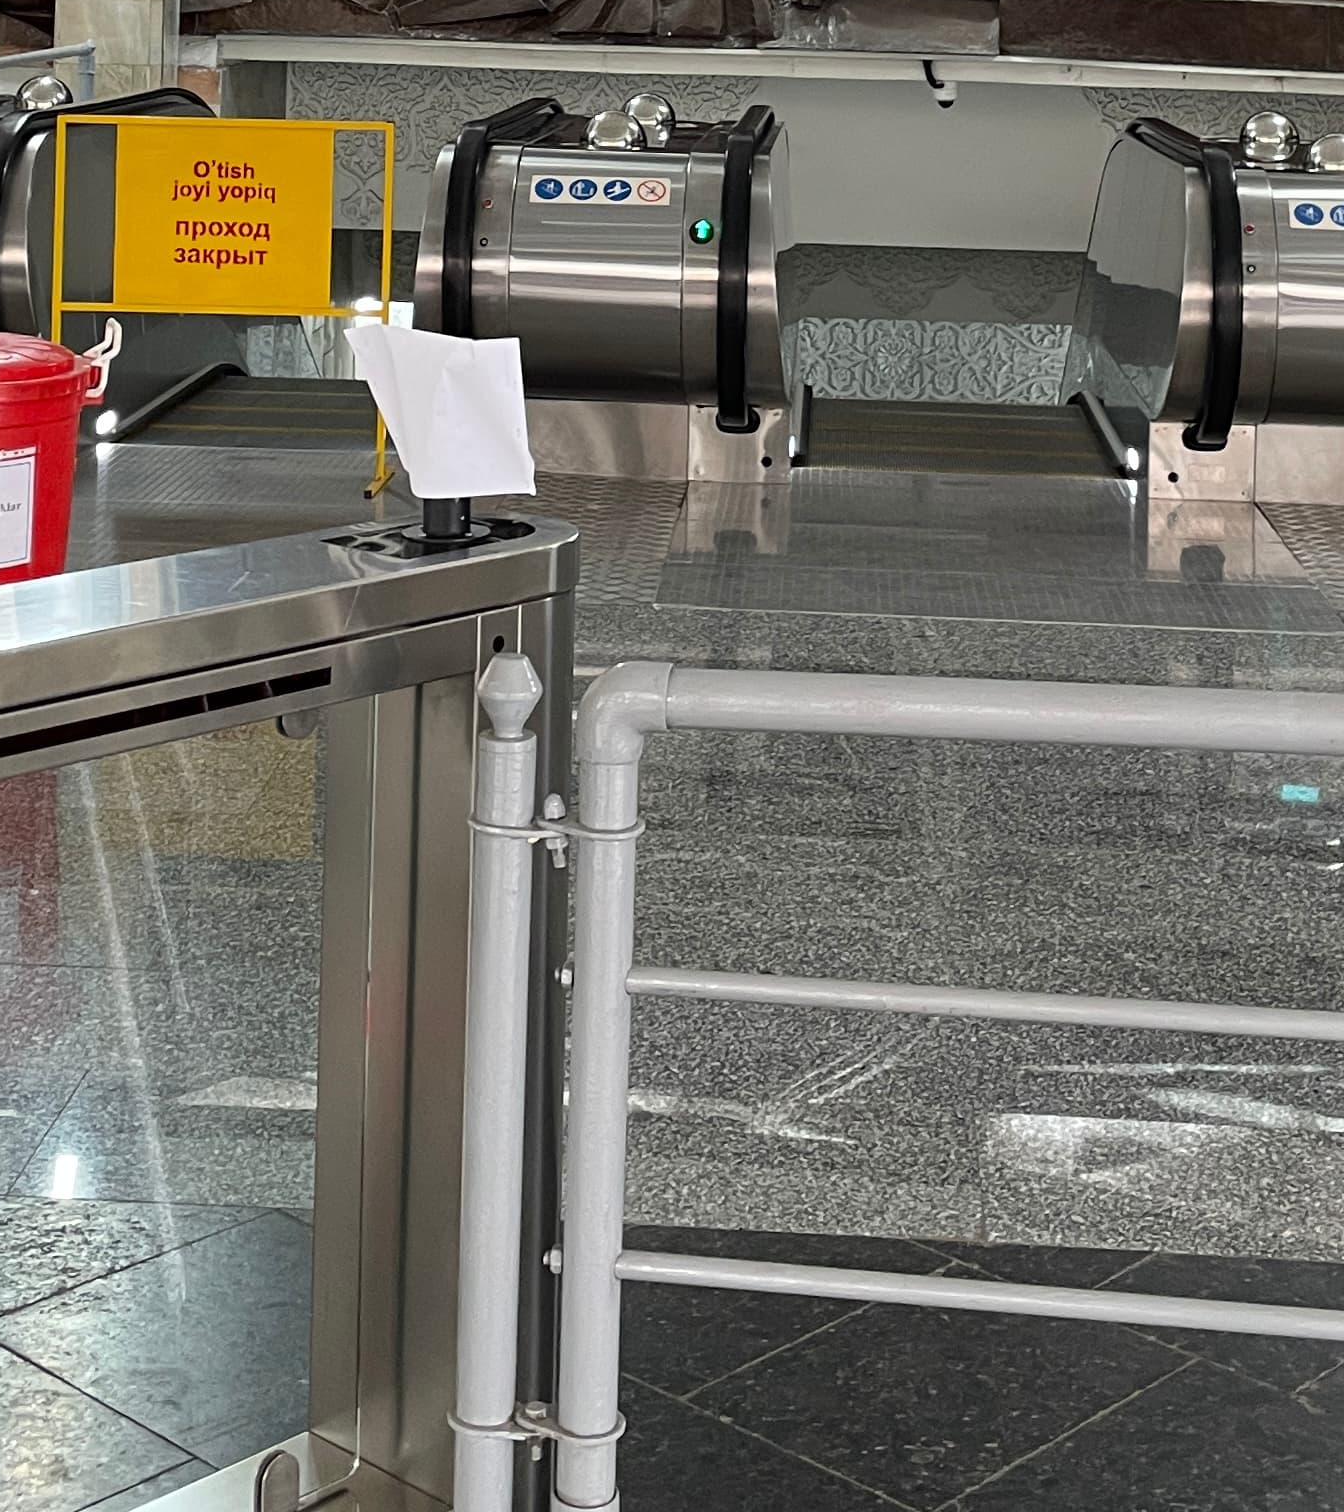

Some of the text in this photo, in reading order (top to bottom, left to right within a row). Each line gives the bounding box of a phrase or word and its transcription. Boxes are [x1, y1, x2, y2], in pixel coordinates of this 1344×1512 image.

[171, 180, 276, 204] joyi yopiq
[175, 219, 271, 242] проход
[173, 246, 269, 270] закрыт
